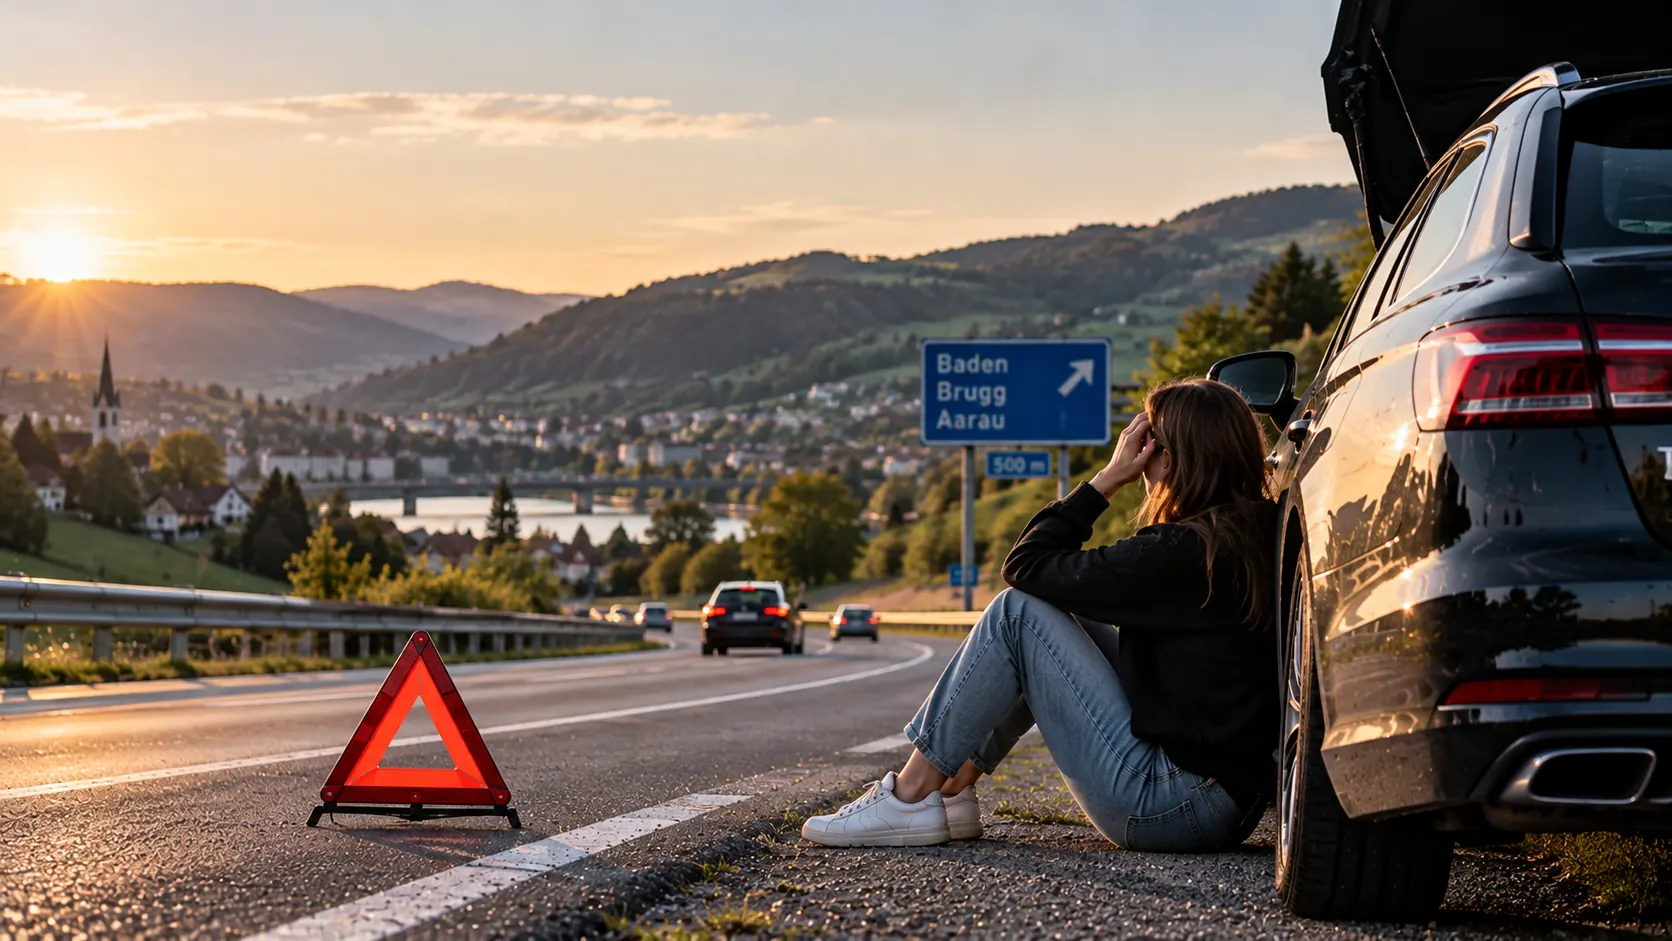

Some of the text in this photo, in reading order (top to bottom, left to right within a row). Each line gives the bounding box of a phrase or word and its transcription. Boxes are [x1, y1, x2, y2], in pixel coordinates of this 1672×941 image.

[937, 352, 1009, 374] Baden
[937, 380, 1007, 407] Brugg
[936, 408, 1006, 430] Aarau
[992, 456, 1046, 474] 500 m
